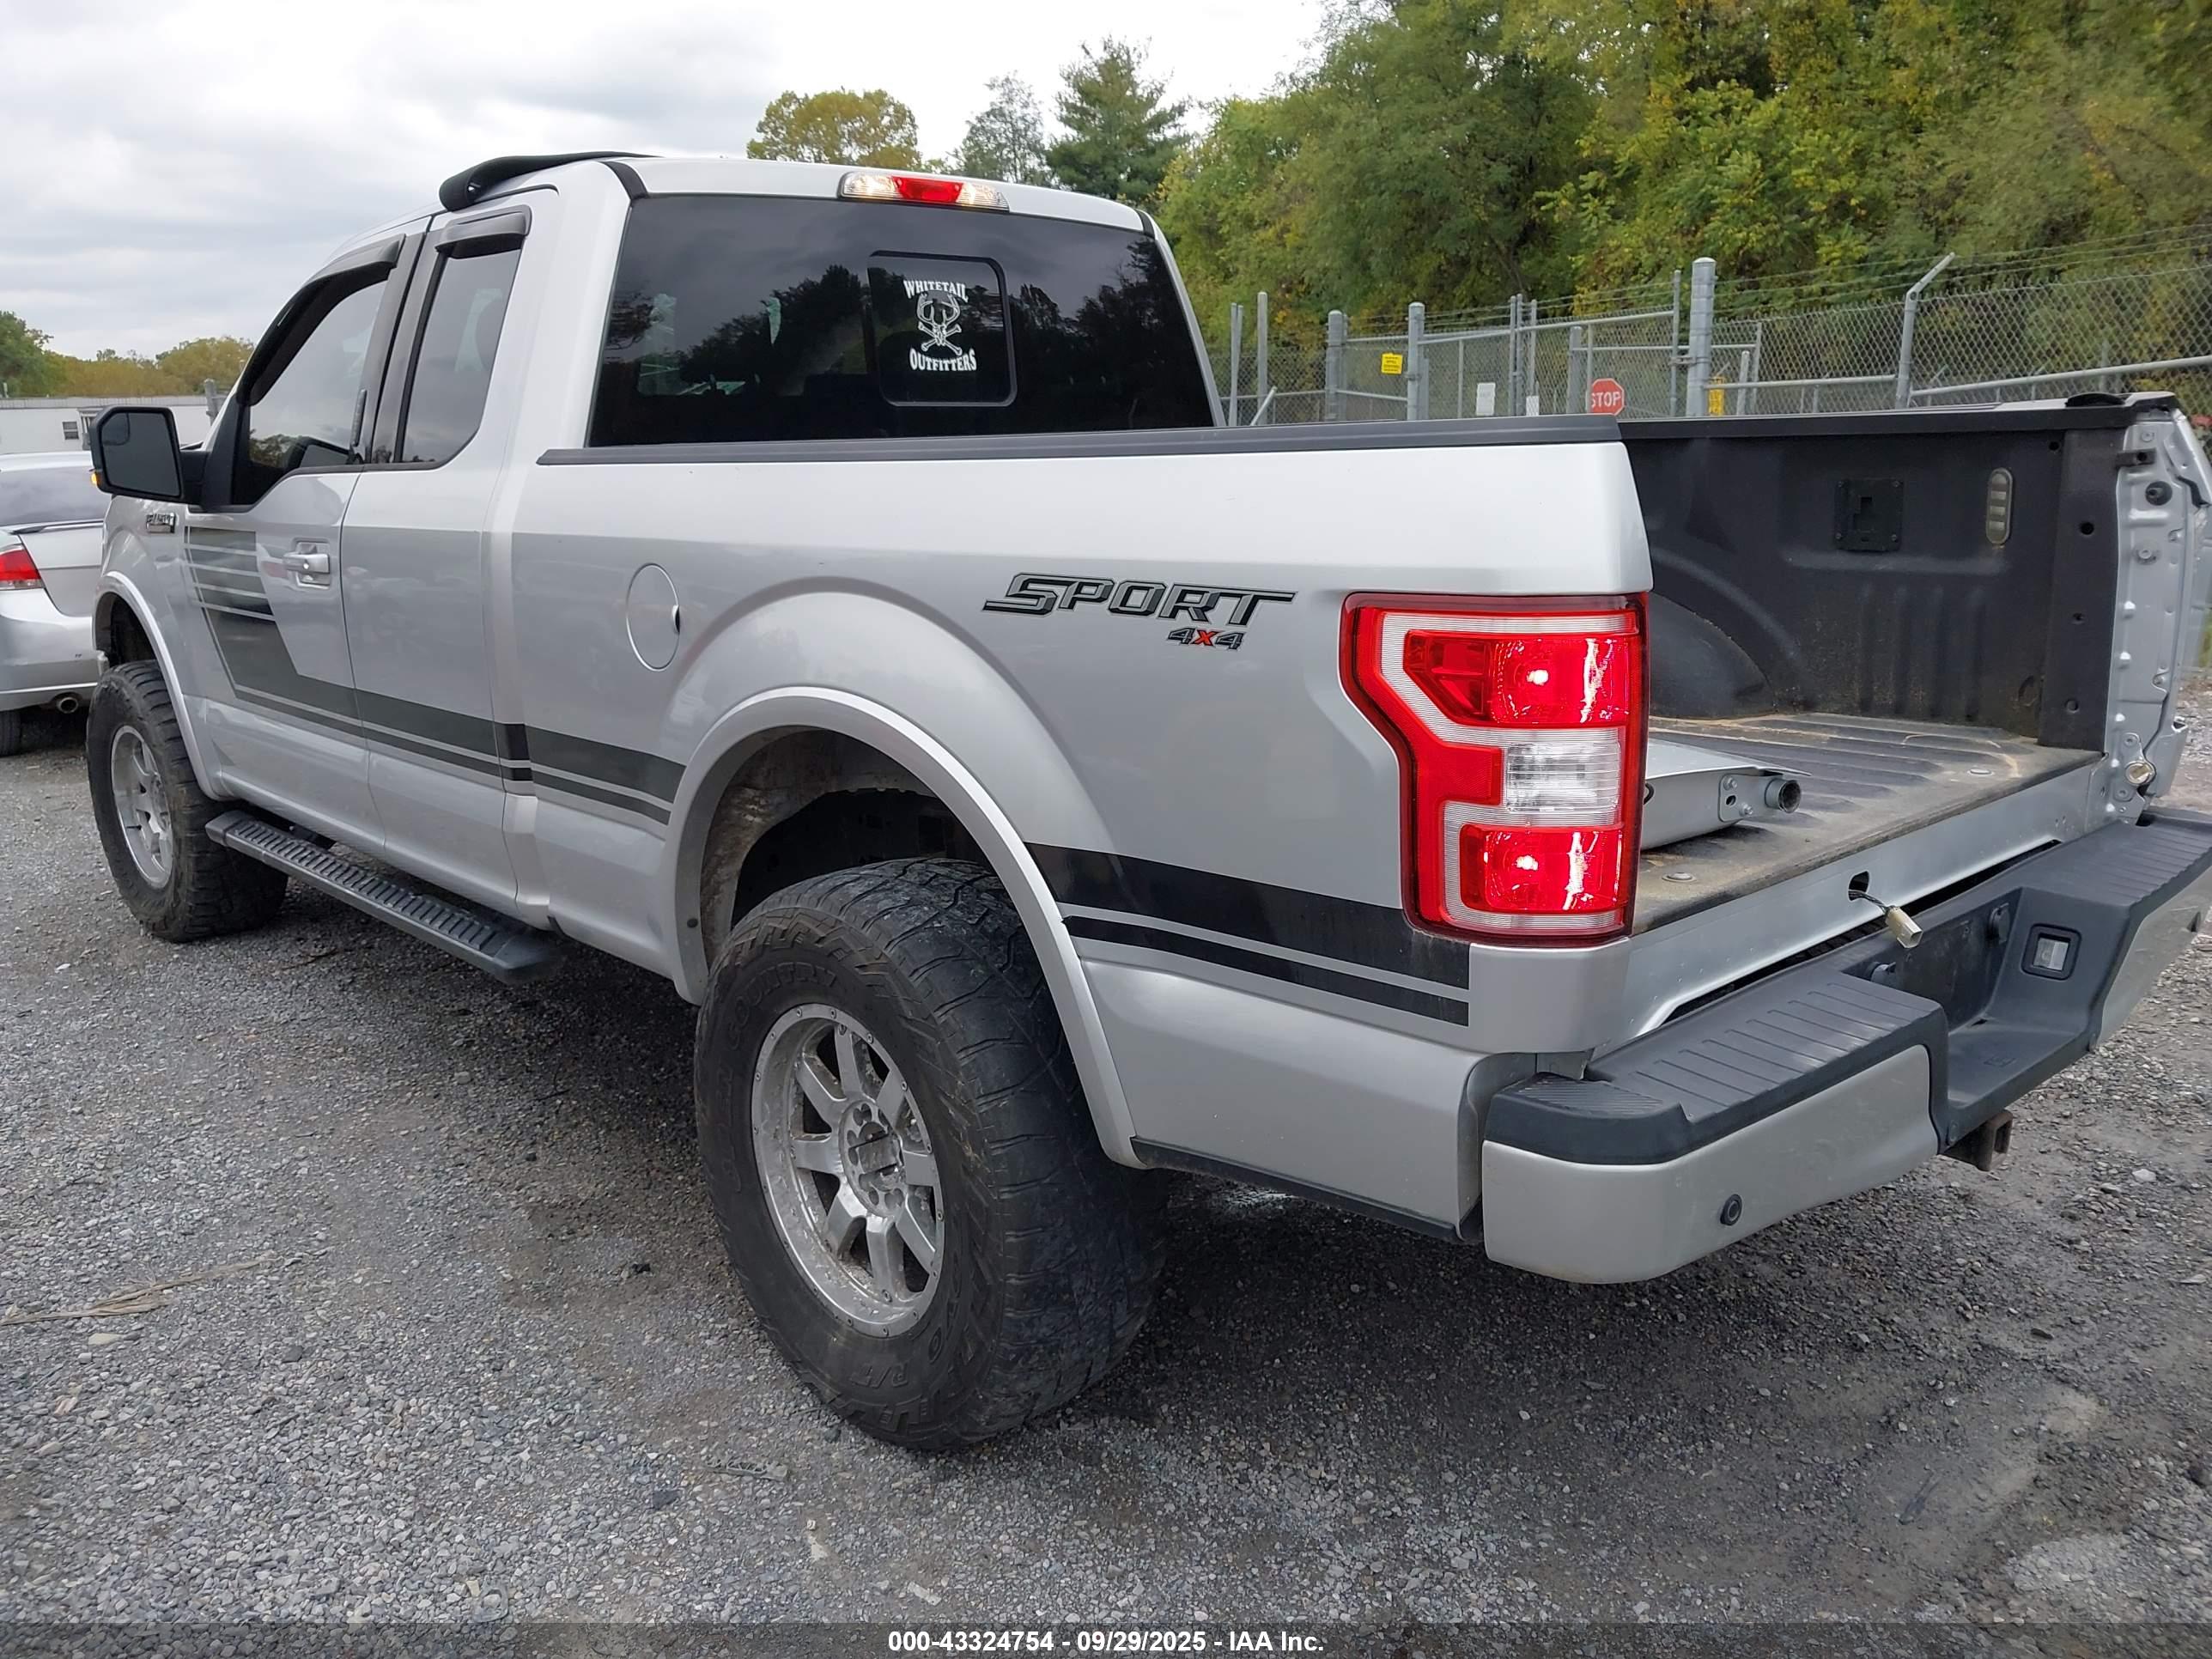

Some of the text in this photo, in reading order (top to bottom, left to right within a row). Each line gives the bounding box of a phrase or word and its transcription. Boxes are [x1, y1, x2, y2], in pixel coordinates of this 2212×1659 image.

[903, 279, 969, 303] WHITETAIL
[908, 347, 977, 371] OUTFITTERS
[1590, 391, 1622, 408] STOP
[981, 572, 1298, 627] SPORT
[728, 959, 838, 1051] COUNTRY
